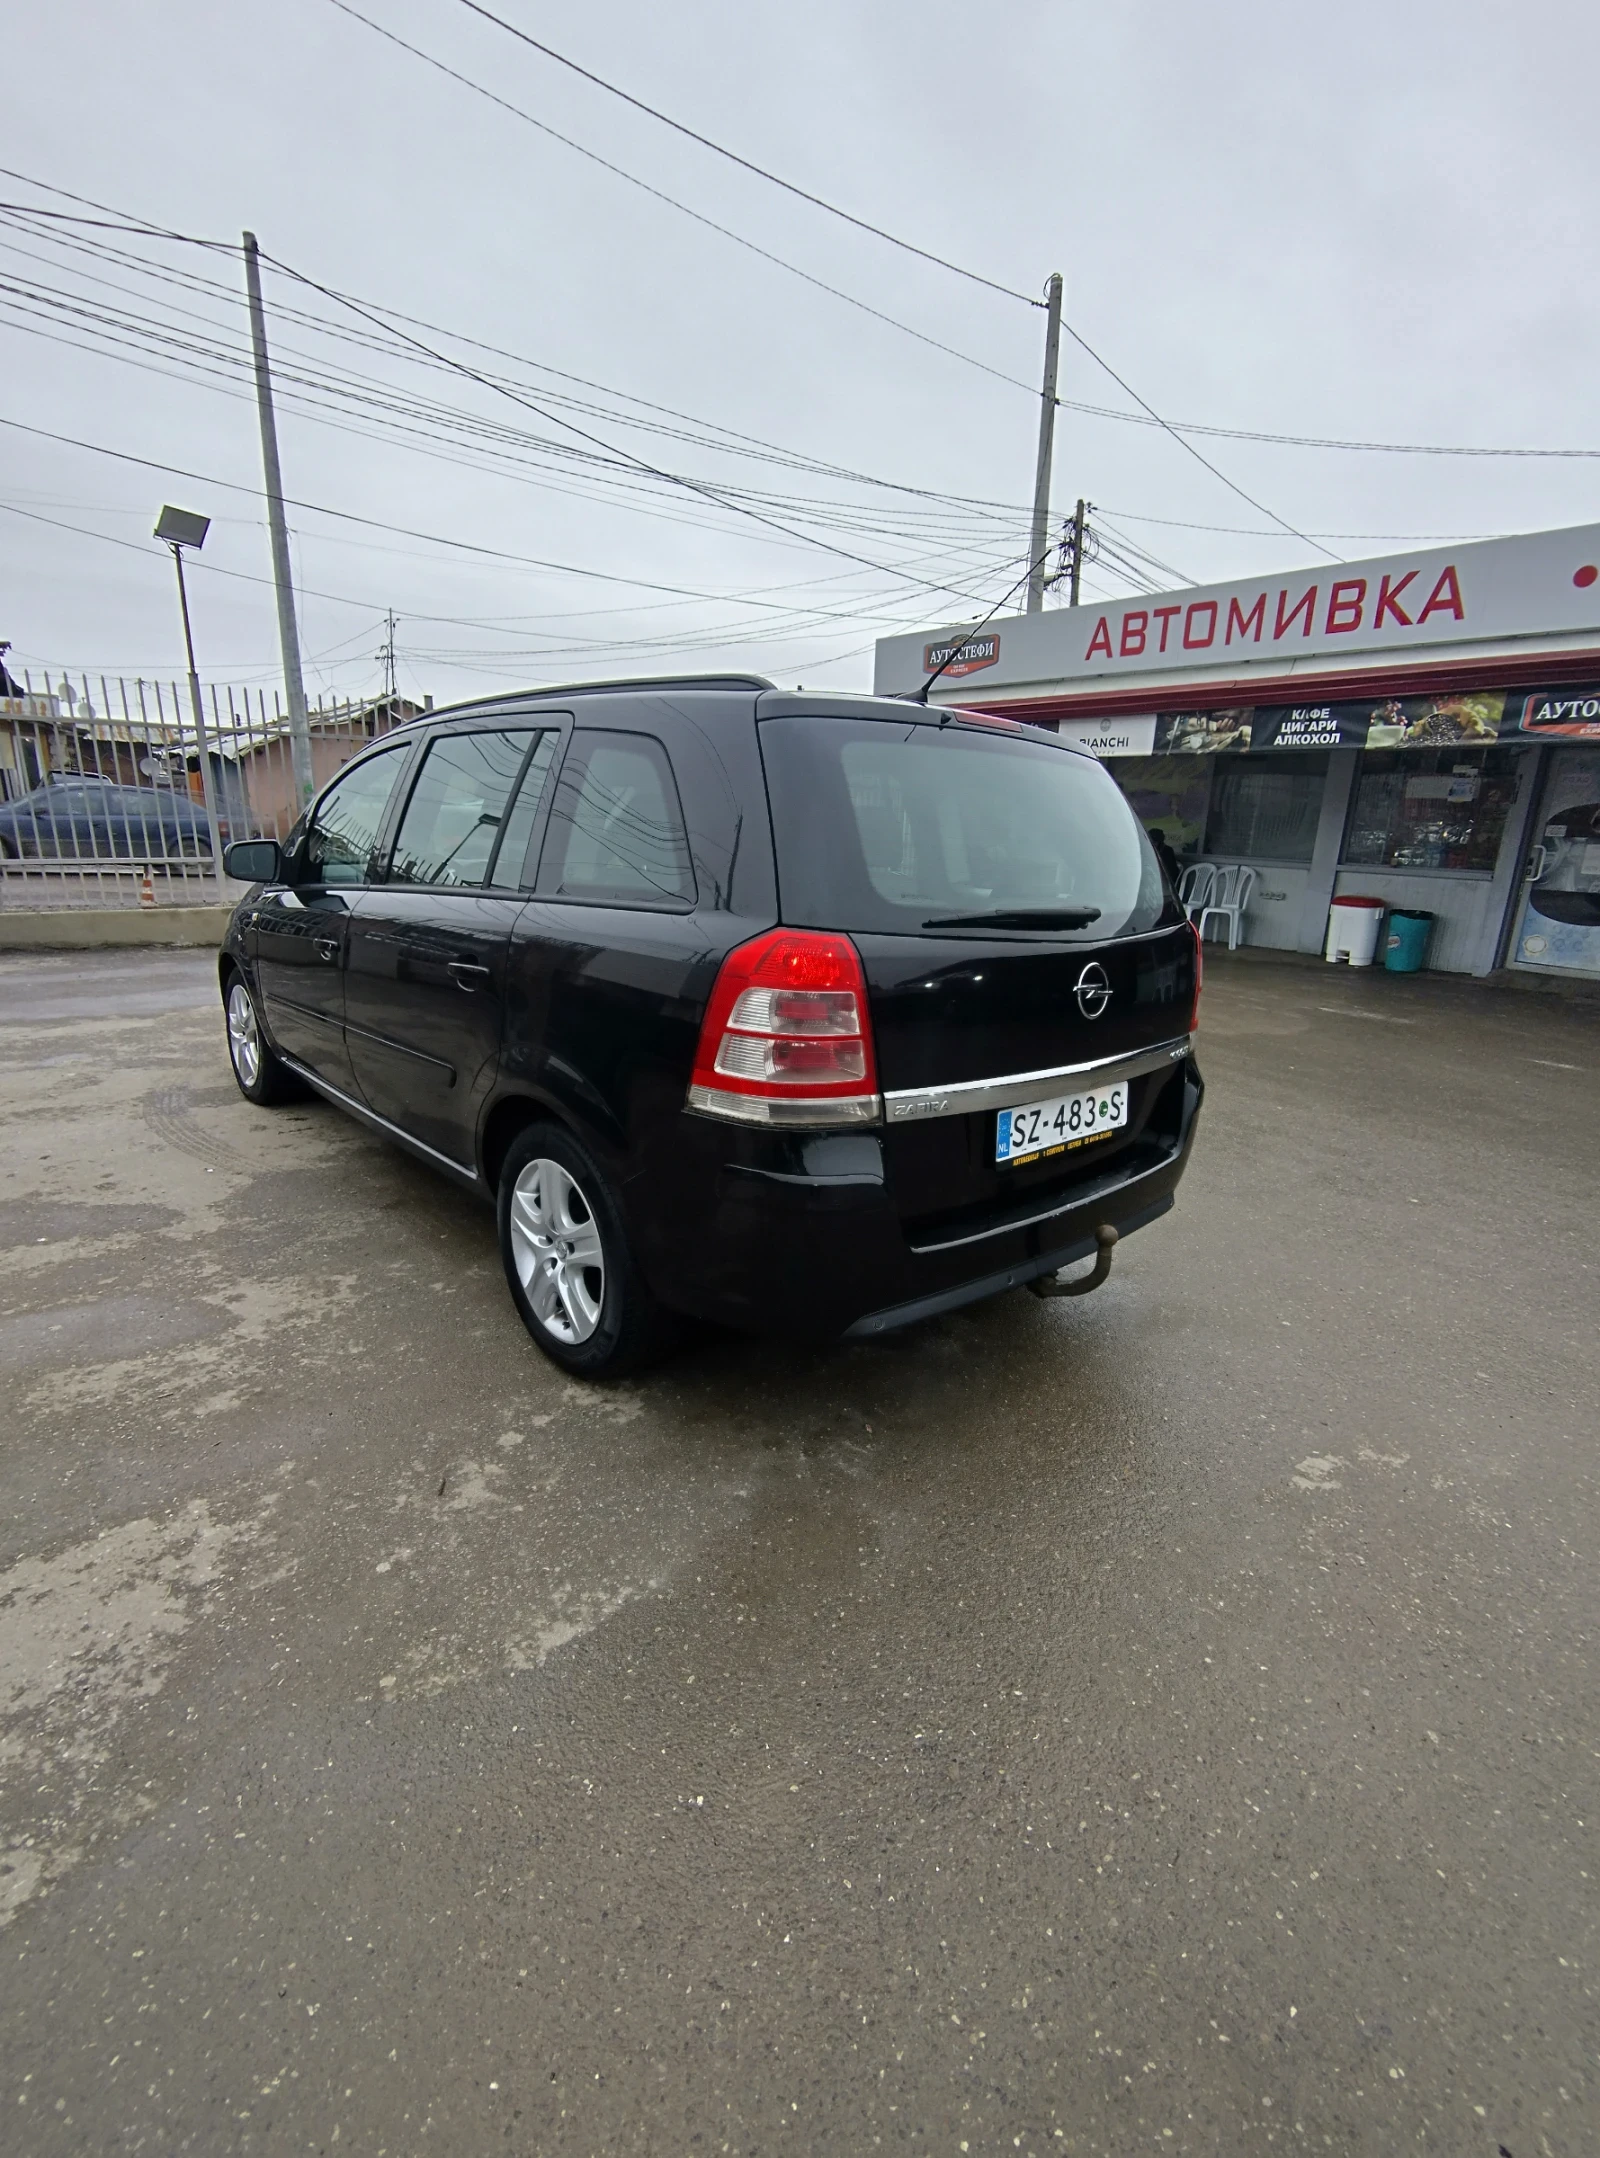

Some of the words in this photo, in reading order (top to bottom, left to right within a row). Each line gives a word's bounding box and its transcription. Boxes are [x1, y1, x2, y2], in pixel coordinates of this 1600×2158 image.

[1085, 565, 1464, 661] АВТОМИВКА
[1291, 708, 1330, 720] КАФЕ
[1536, 699, 1600, 720] АУТО
[1281, 720, 1337, 734] ЦИГАРИ
[1273, 733, 1340, 746] АЛКОХОЛ
[998, 1143, 1009, 1153] NL
